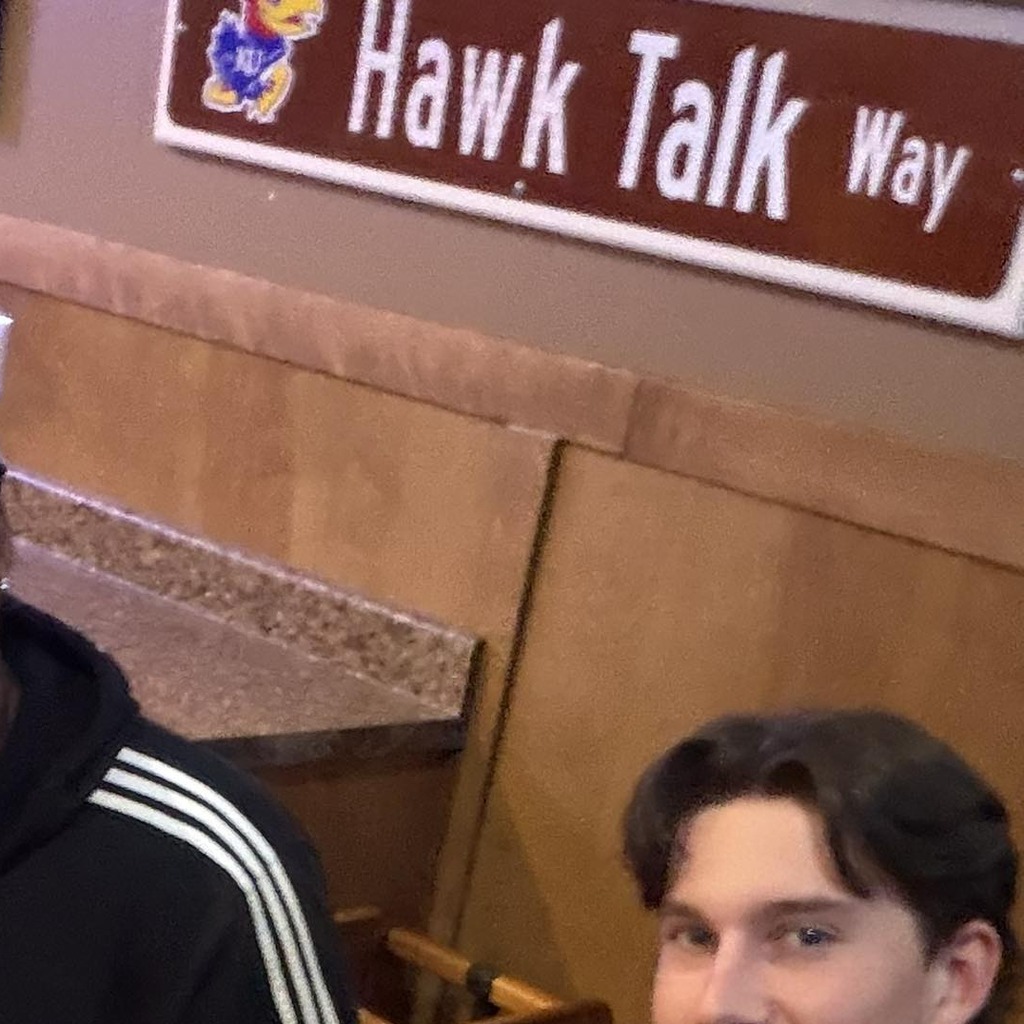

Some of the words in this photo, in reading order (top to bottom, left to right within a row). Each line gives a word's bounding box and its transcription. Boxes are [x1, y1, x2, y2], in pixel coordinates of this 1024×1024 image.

[347, 0, 581, 175] Hawk
[618, 29, 808, 220] Talk
[847, 104, 970, 233] Way
